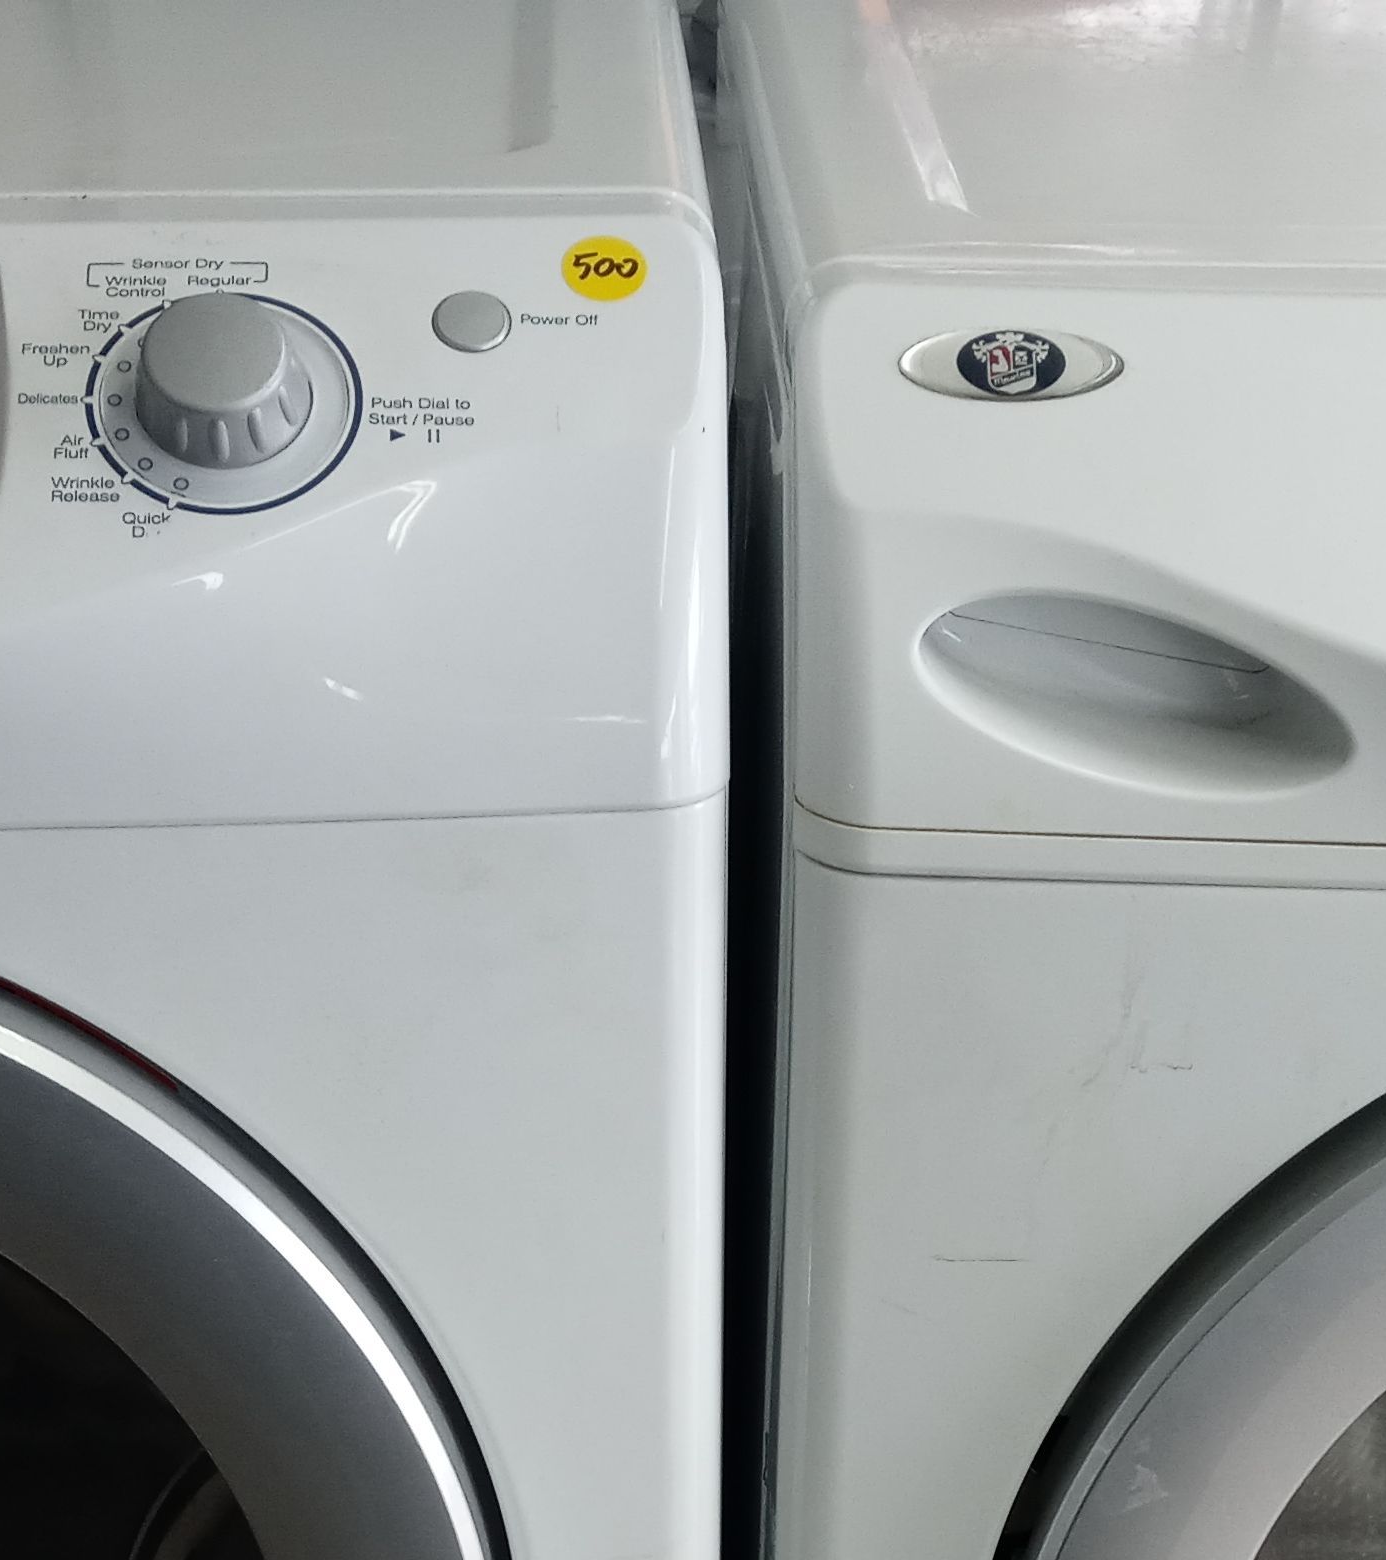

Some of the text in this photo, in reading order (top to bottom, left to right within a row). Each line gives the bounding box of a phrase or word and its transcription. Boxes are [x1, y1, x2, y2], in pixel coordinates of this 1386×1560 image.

[131, 257, 224, 272] Sensor Dry
[572, 253, 639, 280] 500
[105, 274, 166, 286] Wrinkle
[188, 274, 252, 288] Regular
[105, 286, 165, 298] Control
[79, 309, 120, 320] Time
[519, 313, 599, 326] Power Off
[83, 320, 112, 334] Dry
[21, 343, 91, 356] Freshen
[44, 355, 67, 368] Up
[18, 393, 79, 404] Delicates
[371, 398, 471, 410] Push Dial to
[369, 414, 475, 426] Start Pause
[61, 434, 84, 446] Air
[54, 446, 90, 458] Fluff
[51, 476, 115, 489] Wrinkle
[51, 490, 120, 502] Release
[122, 512, 170, 524] Quick
